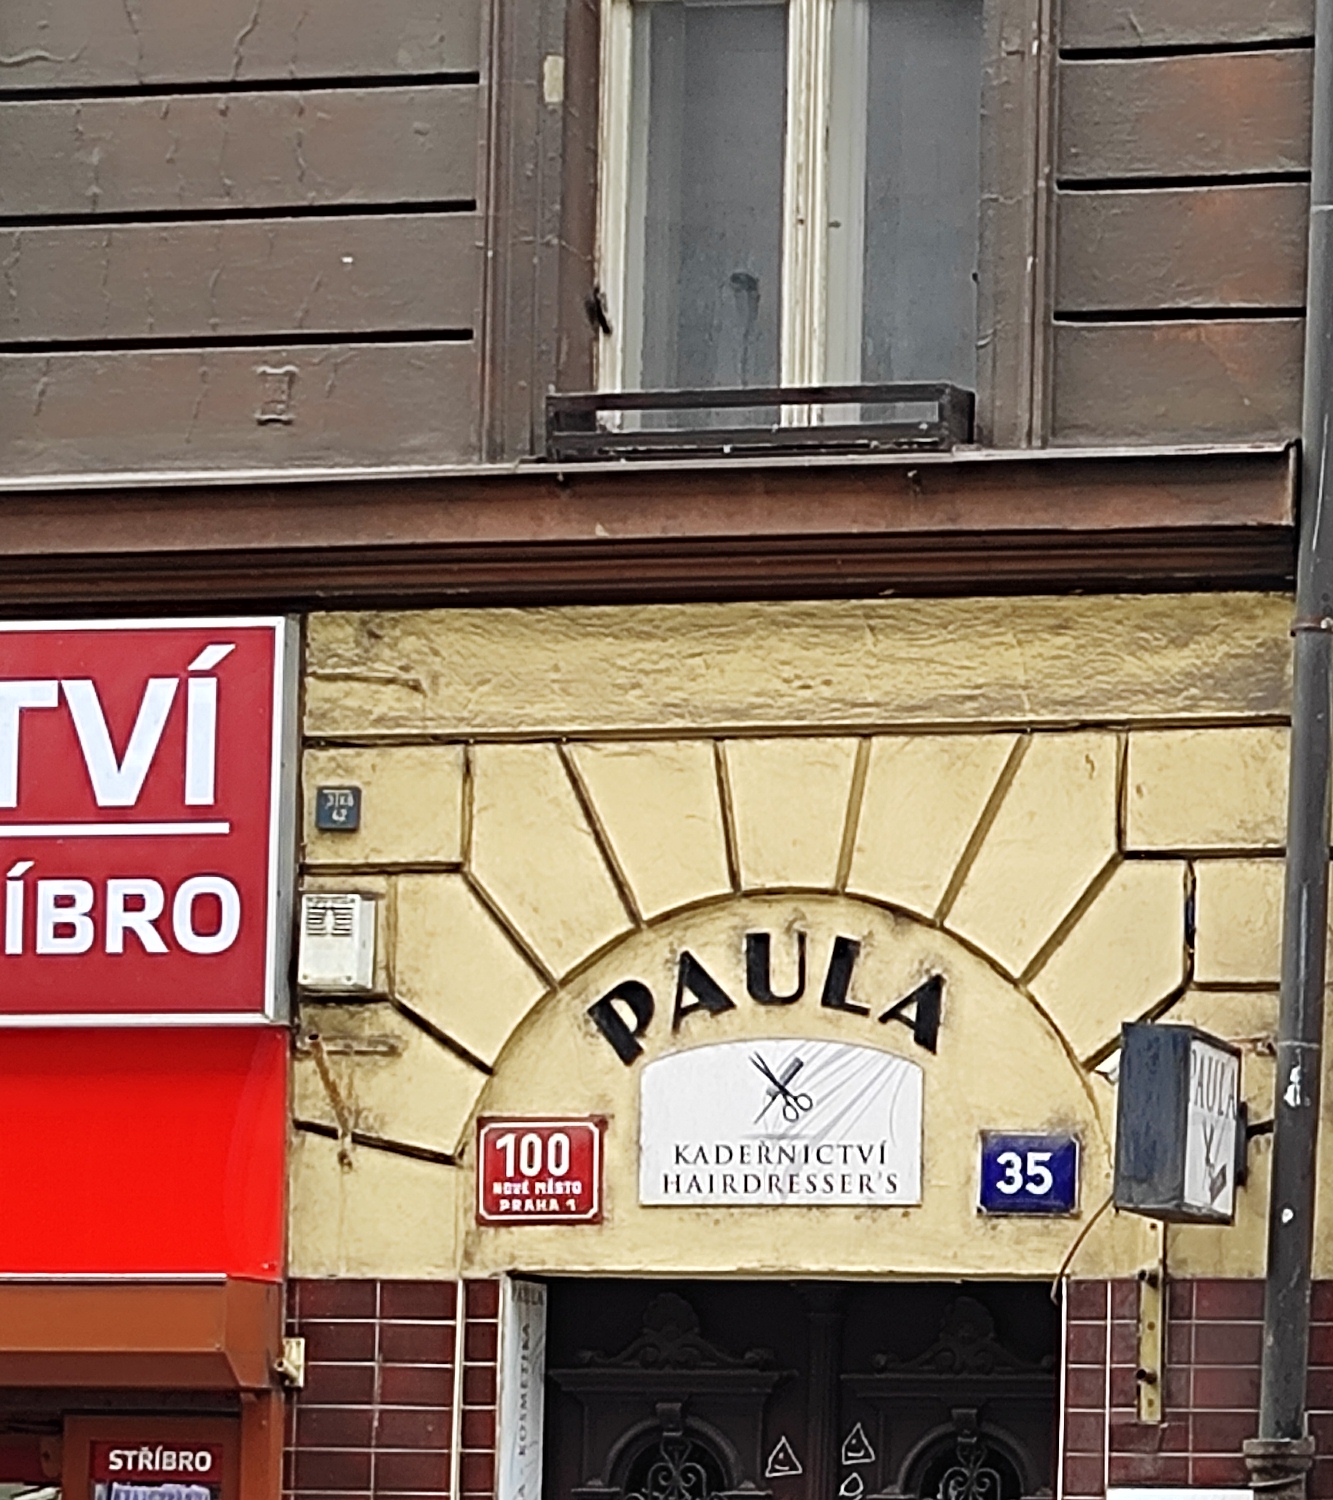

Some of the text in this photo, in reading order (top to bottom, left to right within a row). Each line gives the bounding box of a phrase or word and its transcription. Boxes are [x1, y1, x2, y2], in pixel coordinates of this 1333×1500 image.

[587, 931, 946, 1066] PAULA
[495, 1132, 570, 1178] 100
[674, 1139, 888, 1166] KADEŘNICTVÍ
[662, 1172, 899, 1196] HAIRDRESSER'S
[996, 1151, 1055, 1195] 35
[492, 1179, 531, 1195] NOVÉ
[499, 1198, 577, 1212] PRAHA 1
[108, 1445, 212, 1472] STŘÍBRO
